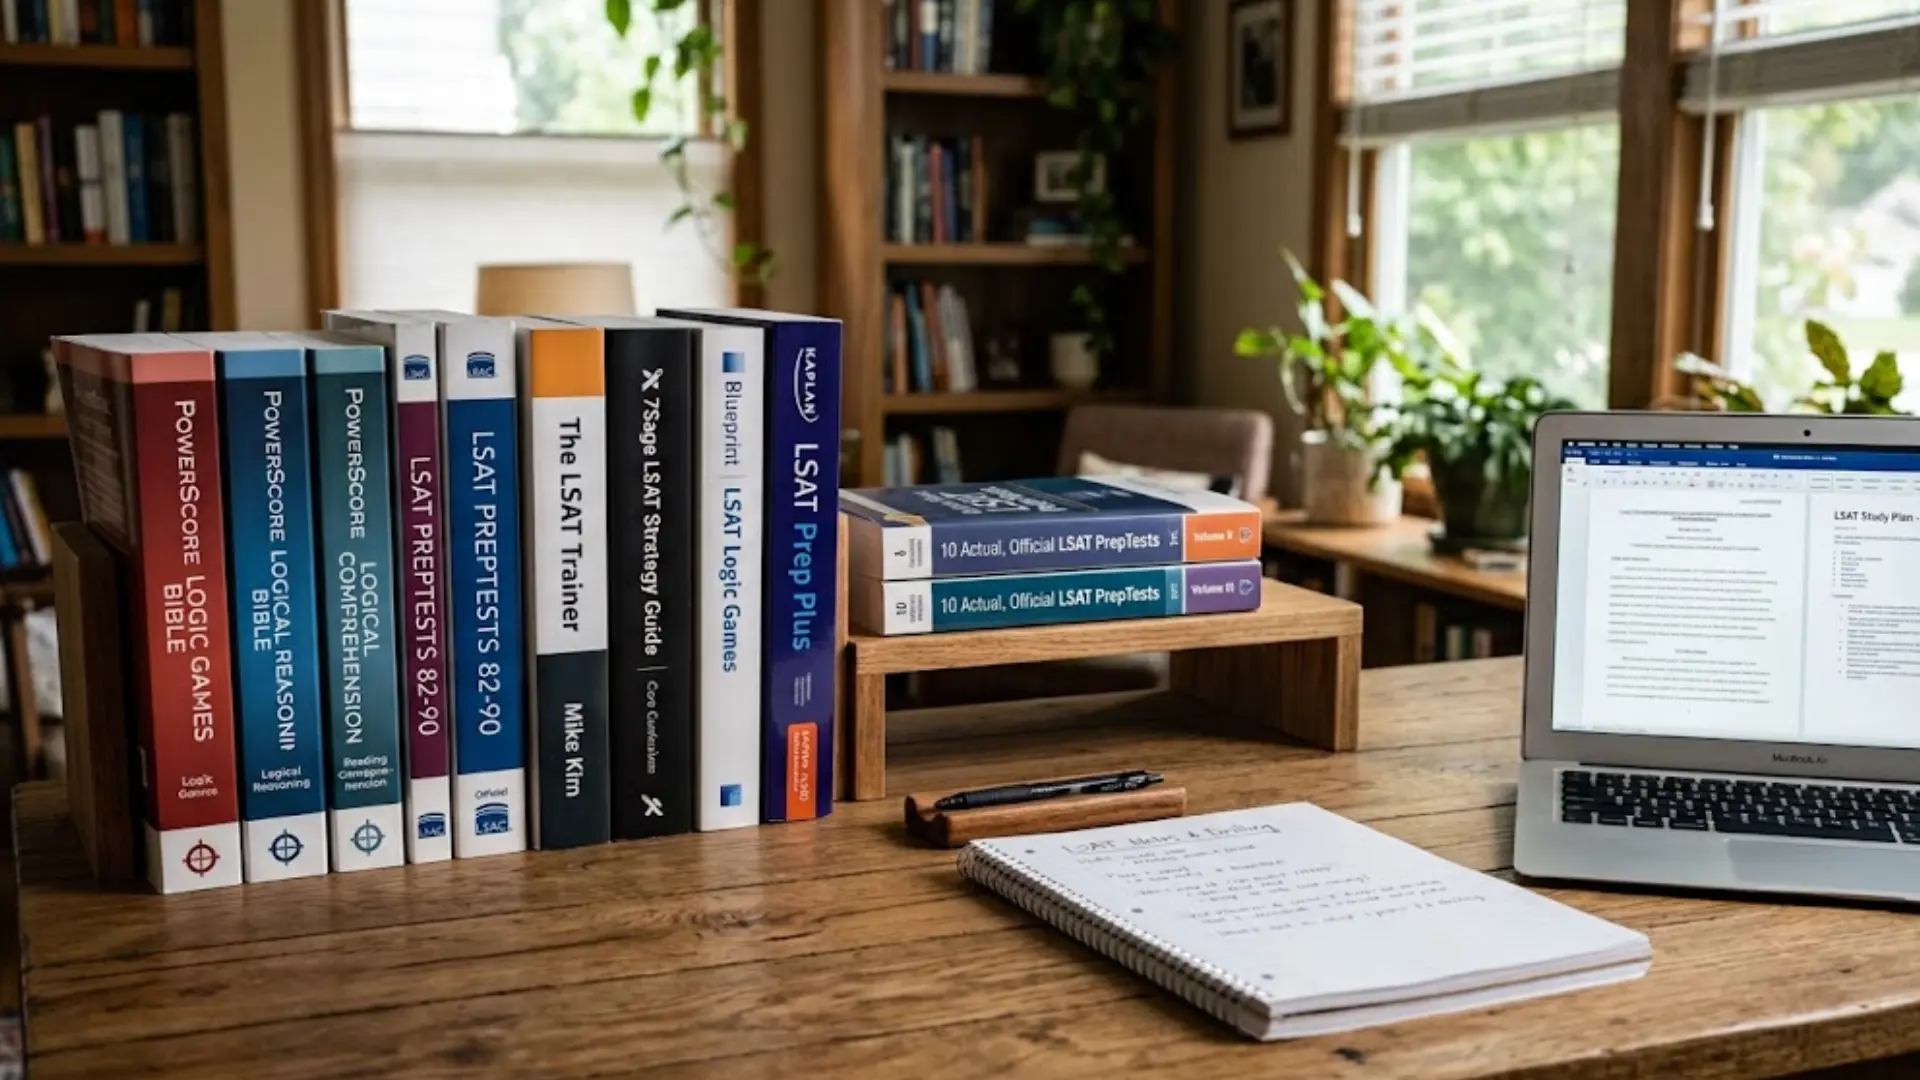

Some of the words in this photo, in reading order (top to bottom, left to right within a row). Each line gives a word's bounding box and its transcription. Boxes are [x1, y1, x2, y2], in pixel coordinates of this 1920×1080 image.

[803, 346, 817, 415] KAPLAN
[559, 416, 582, 465] The
[639, 396, 661, 456] 7Sage
[722, 380, 742, 466] Blueprint
[410, 456, 433, 516] LSAT
[472, 431, 496, 495] LSAT
[643, 460, 661, 510] LSAT
[793, 443, 819, 512] LSAT
[560, 473, 583, 535] LSAT
[723, 487, 742, 538] LSAT
[1833, 510, 1859, 521] LSAT
[1861, 511, 1889, 524] Study
[1891, 511, 1914, 523] Plan
[639, 513, 661, 596] Strategy
[718, 545, 742, 599] Logic
[788, 522, 818, 585] Prep
[941, 541, 957, 559] 10
[960, 539, 1007, 558] Actual,
[1008, 536, 1054, 554] Official
[1058, 533, 1092, 552] LSAT
[1095, 531, 1160, 553] PrepTests
[271, 550, 291, 645] LOGICAL
[360, 561, 380, 657] LOGICAL
[412, 523, 438, 660] PREPTESTS
[474, 504, 500, 653] PREPTESTS
[561, 543, 584, 632] Trainer
[941, 596, 957, 614] 10
[960, 593, 1007, 612] Actual,
[1008, 591, 1054, 609] Official
[1058, 587, 1092, 607] LSAT
[1095, 585, 1160, 607] PrepTests
[163, 583, 186, 654] BIBLE
[186, 575, 209, 650] LOGIC
[252, 588, 272, 652] BIBLE
[644, 600, 663, 656] Guide
[722, 604, 741, 673] Games
[791, 592, 817, 651] Plus
[190, 656, 214, 742] GAMES
[416, 667, 440, 736] 82-90
[477, 662, 501, 736] 82-90
[563, 702, 584, 752] Mike
[565, 757, 584, 797] Kim
